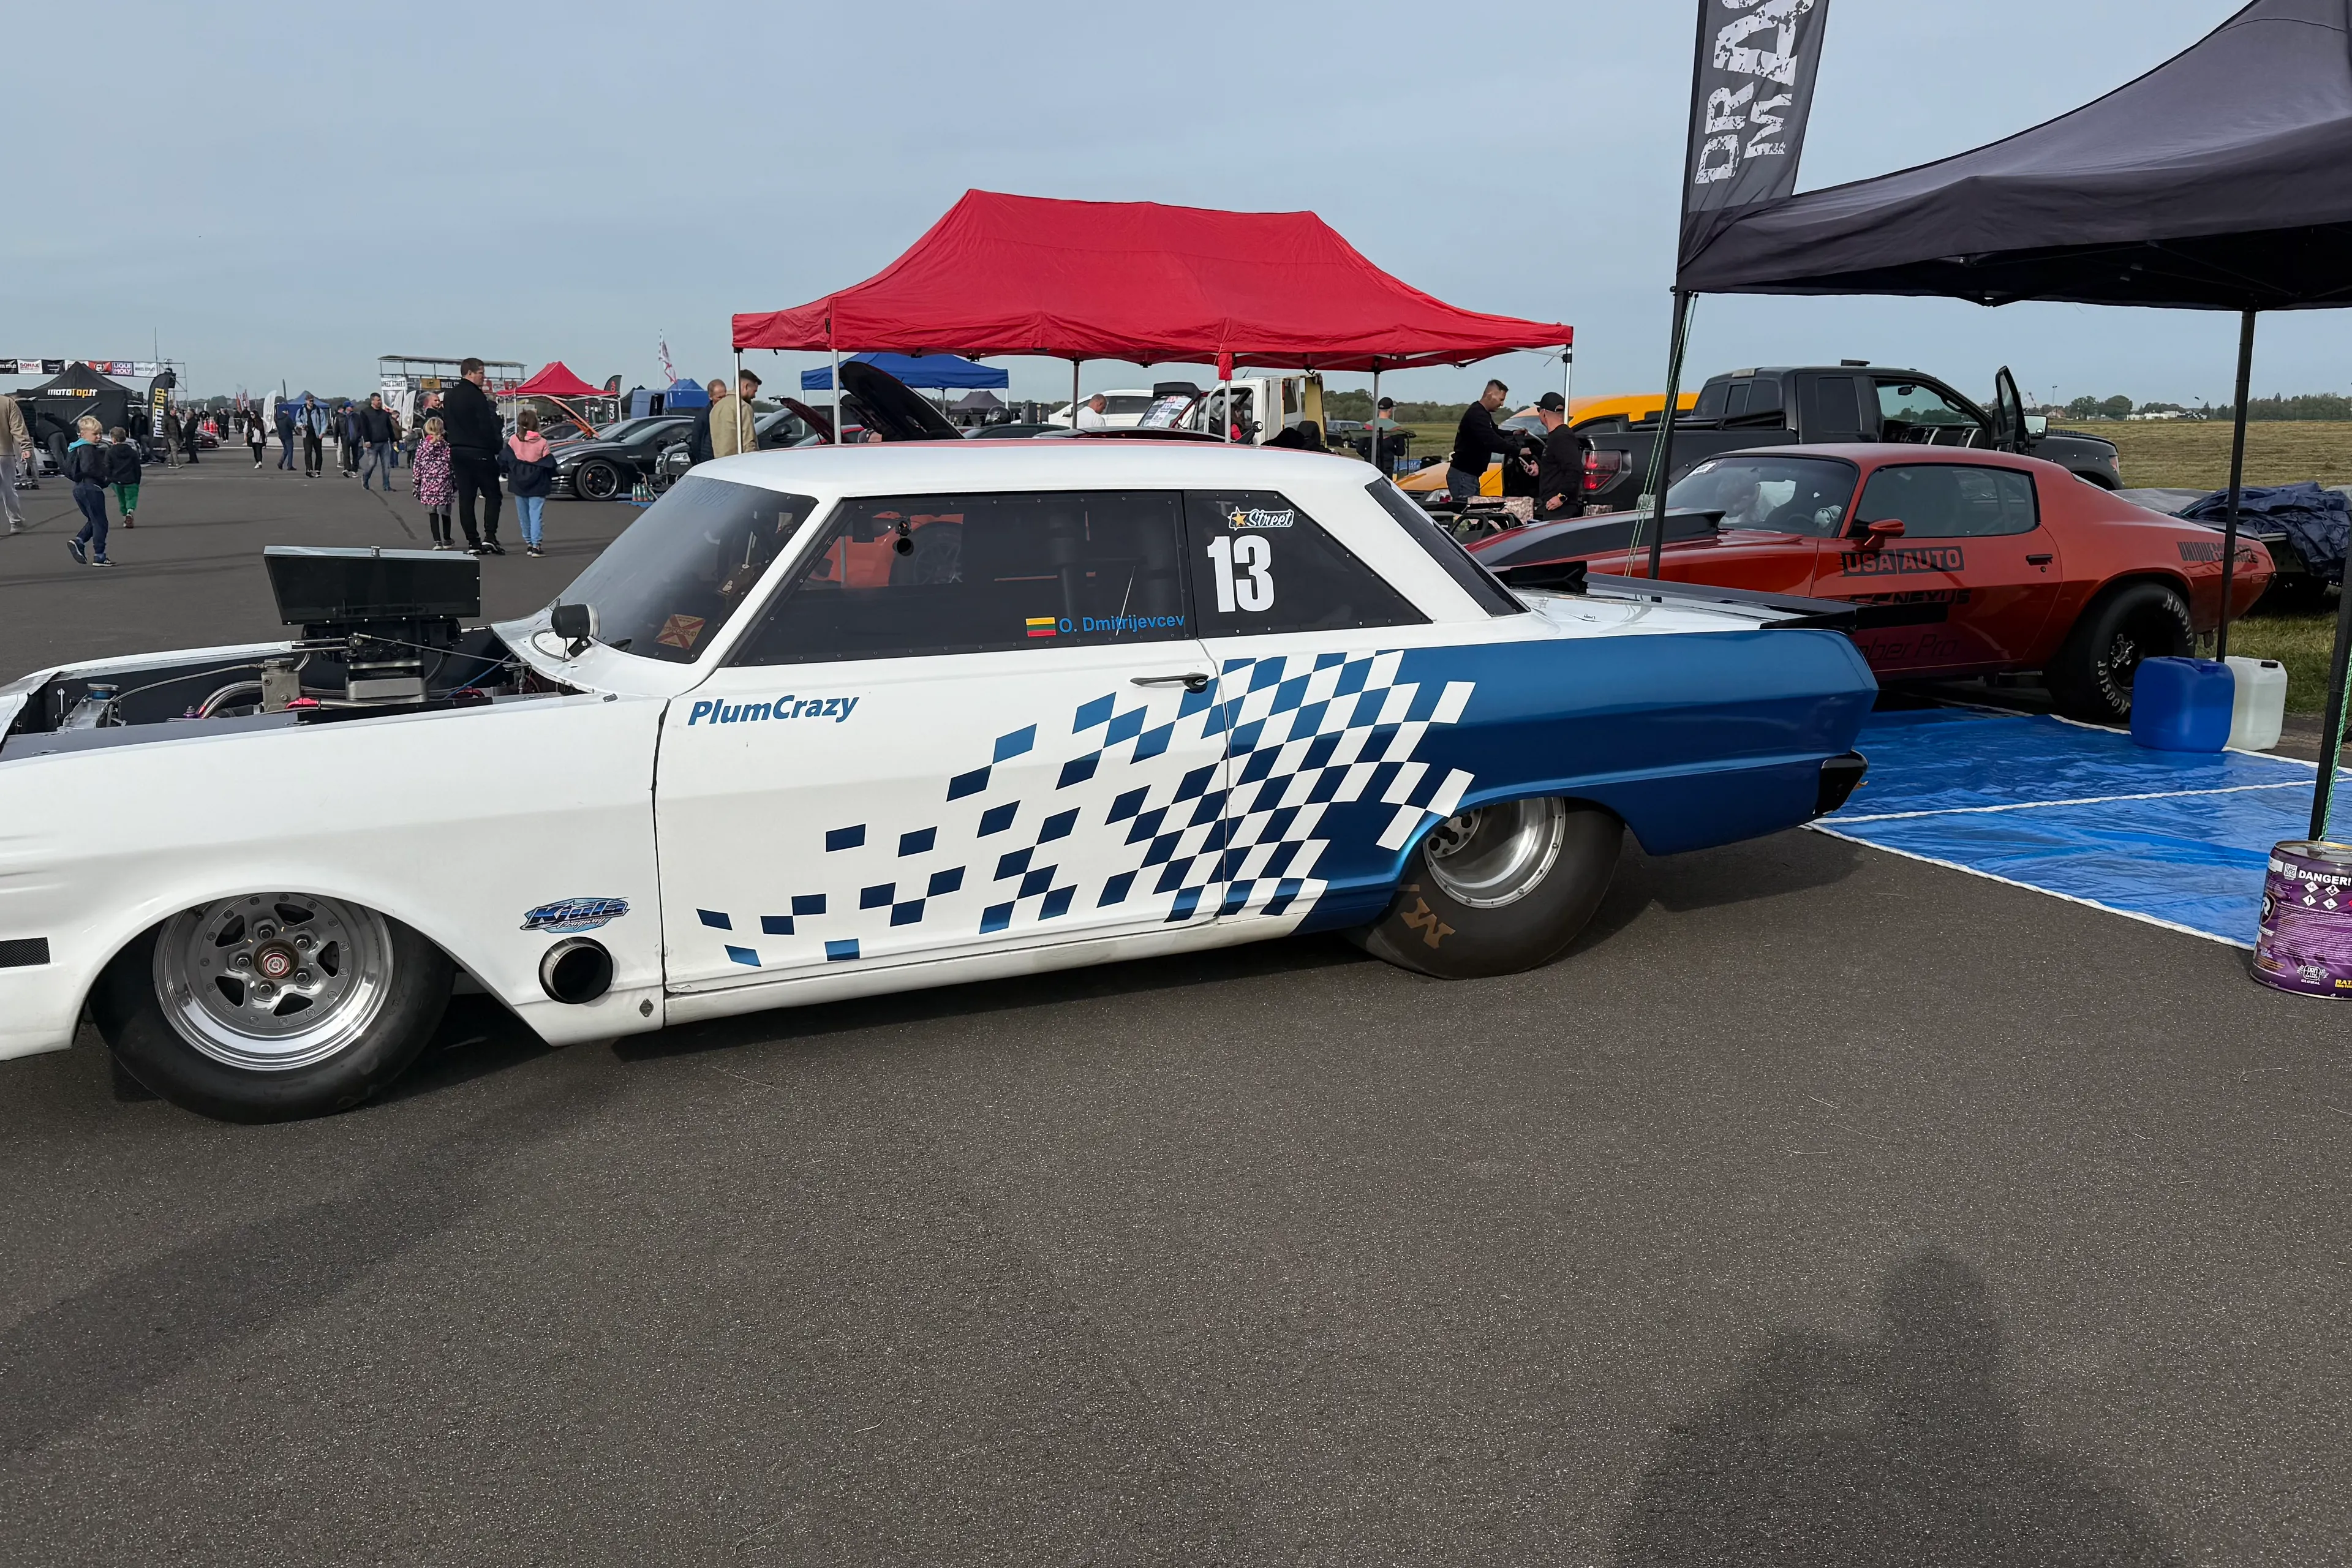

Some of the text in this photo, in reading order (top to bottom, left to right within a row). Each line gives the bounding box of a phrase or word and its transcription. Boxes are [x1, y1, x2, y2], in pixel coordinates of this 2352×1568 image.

[1246, 510, 1292, 527] Street
[1845, 549, 1961, 573] USA AUTO
[1207, 535, 1275, 612] 13
[1058, 614, 1185, 633] O. Dmitrijevcev
[687, 695, 860, 726] PlumCrazy
[2298, 869, 2351, 886] DANGER!
